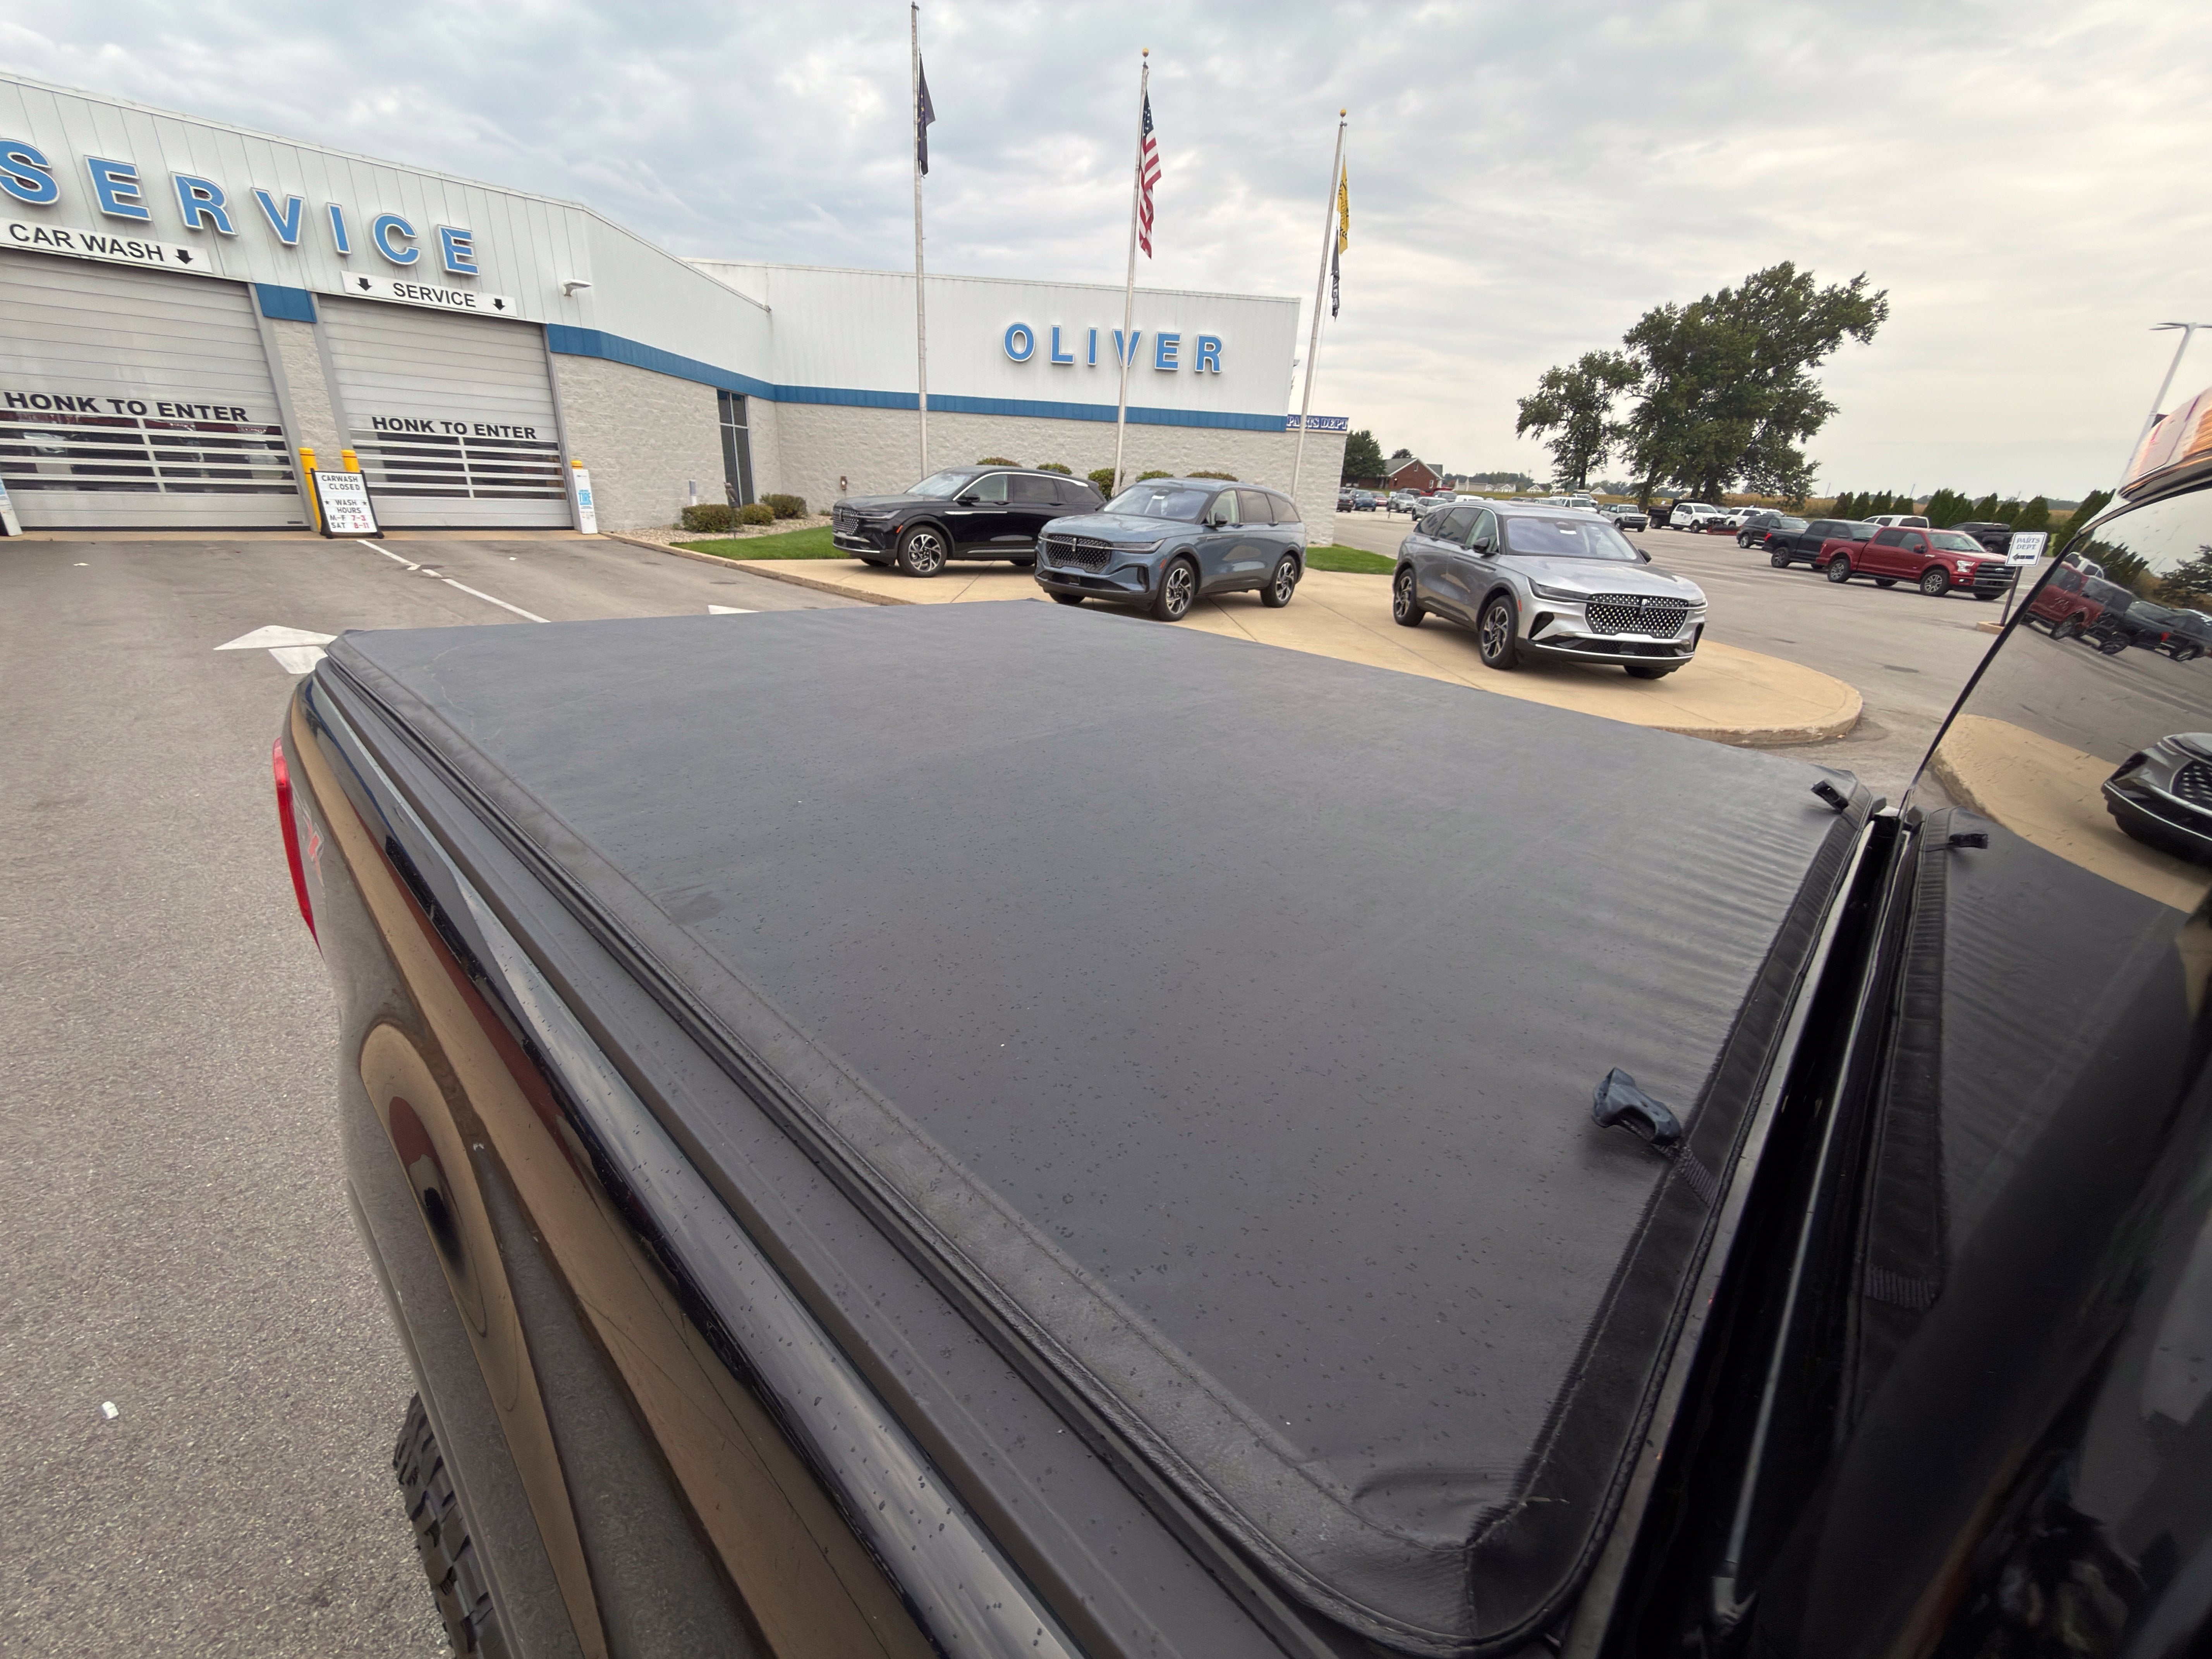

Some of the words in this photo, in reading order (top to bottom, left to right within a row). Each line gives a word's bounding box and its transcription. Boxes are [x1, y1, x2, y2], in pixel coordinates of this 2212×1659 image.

[0, 138, 479, 276] SERVICE
[9, 224, 76, 249] CAR
[79, 234, 165, 262] WASH
[393, 283, 476, 308] SERVICE
[1004, 322, 1223, 373] OLIVER
[3, 392, 101, 413] HONK
[107, 398, 147, 416] TO
[156, 402, 249, 422] ENTER
[372, 416, 436, 433] HONK
[440, 421, 467, 435] TO
[474, 424, 537, 439] ENTER
[1286, 416, 1319, 428] PATS
[1321, 418, 1348, 429] DEPT
